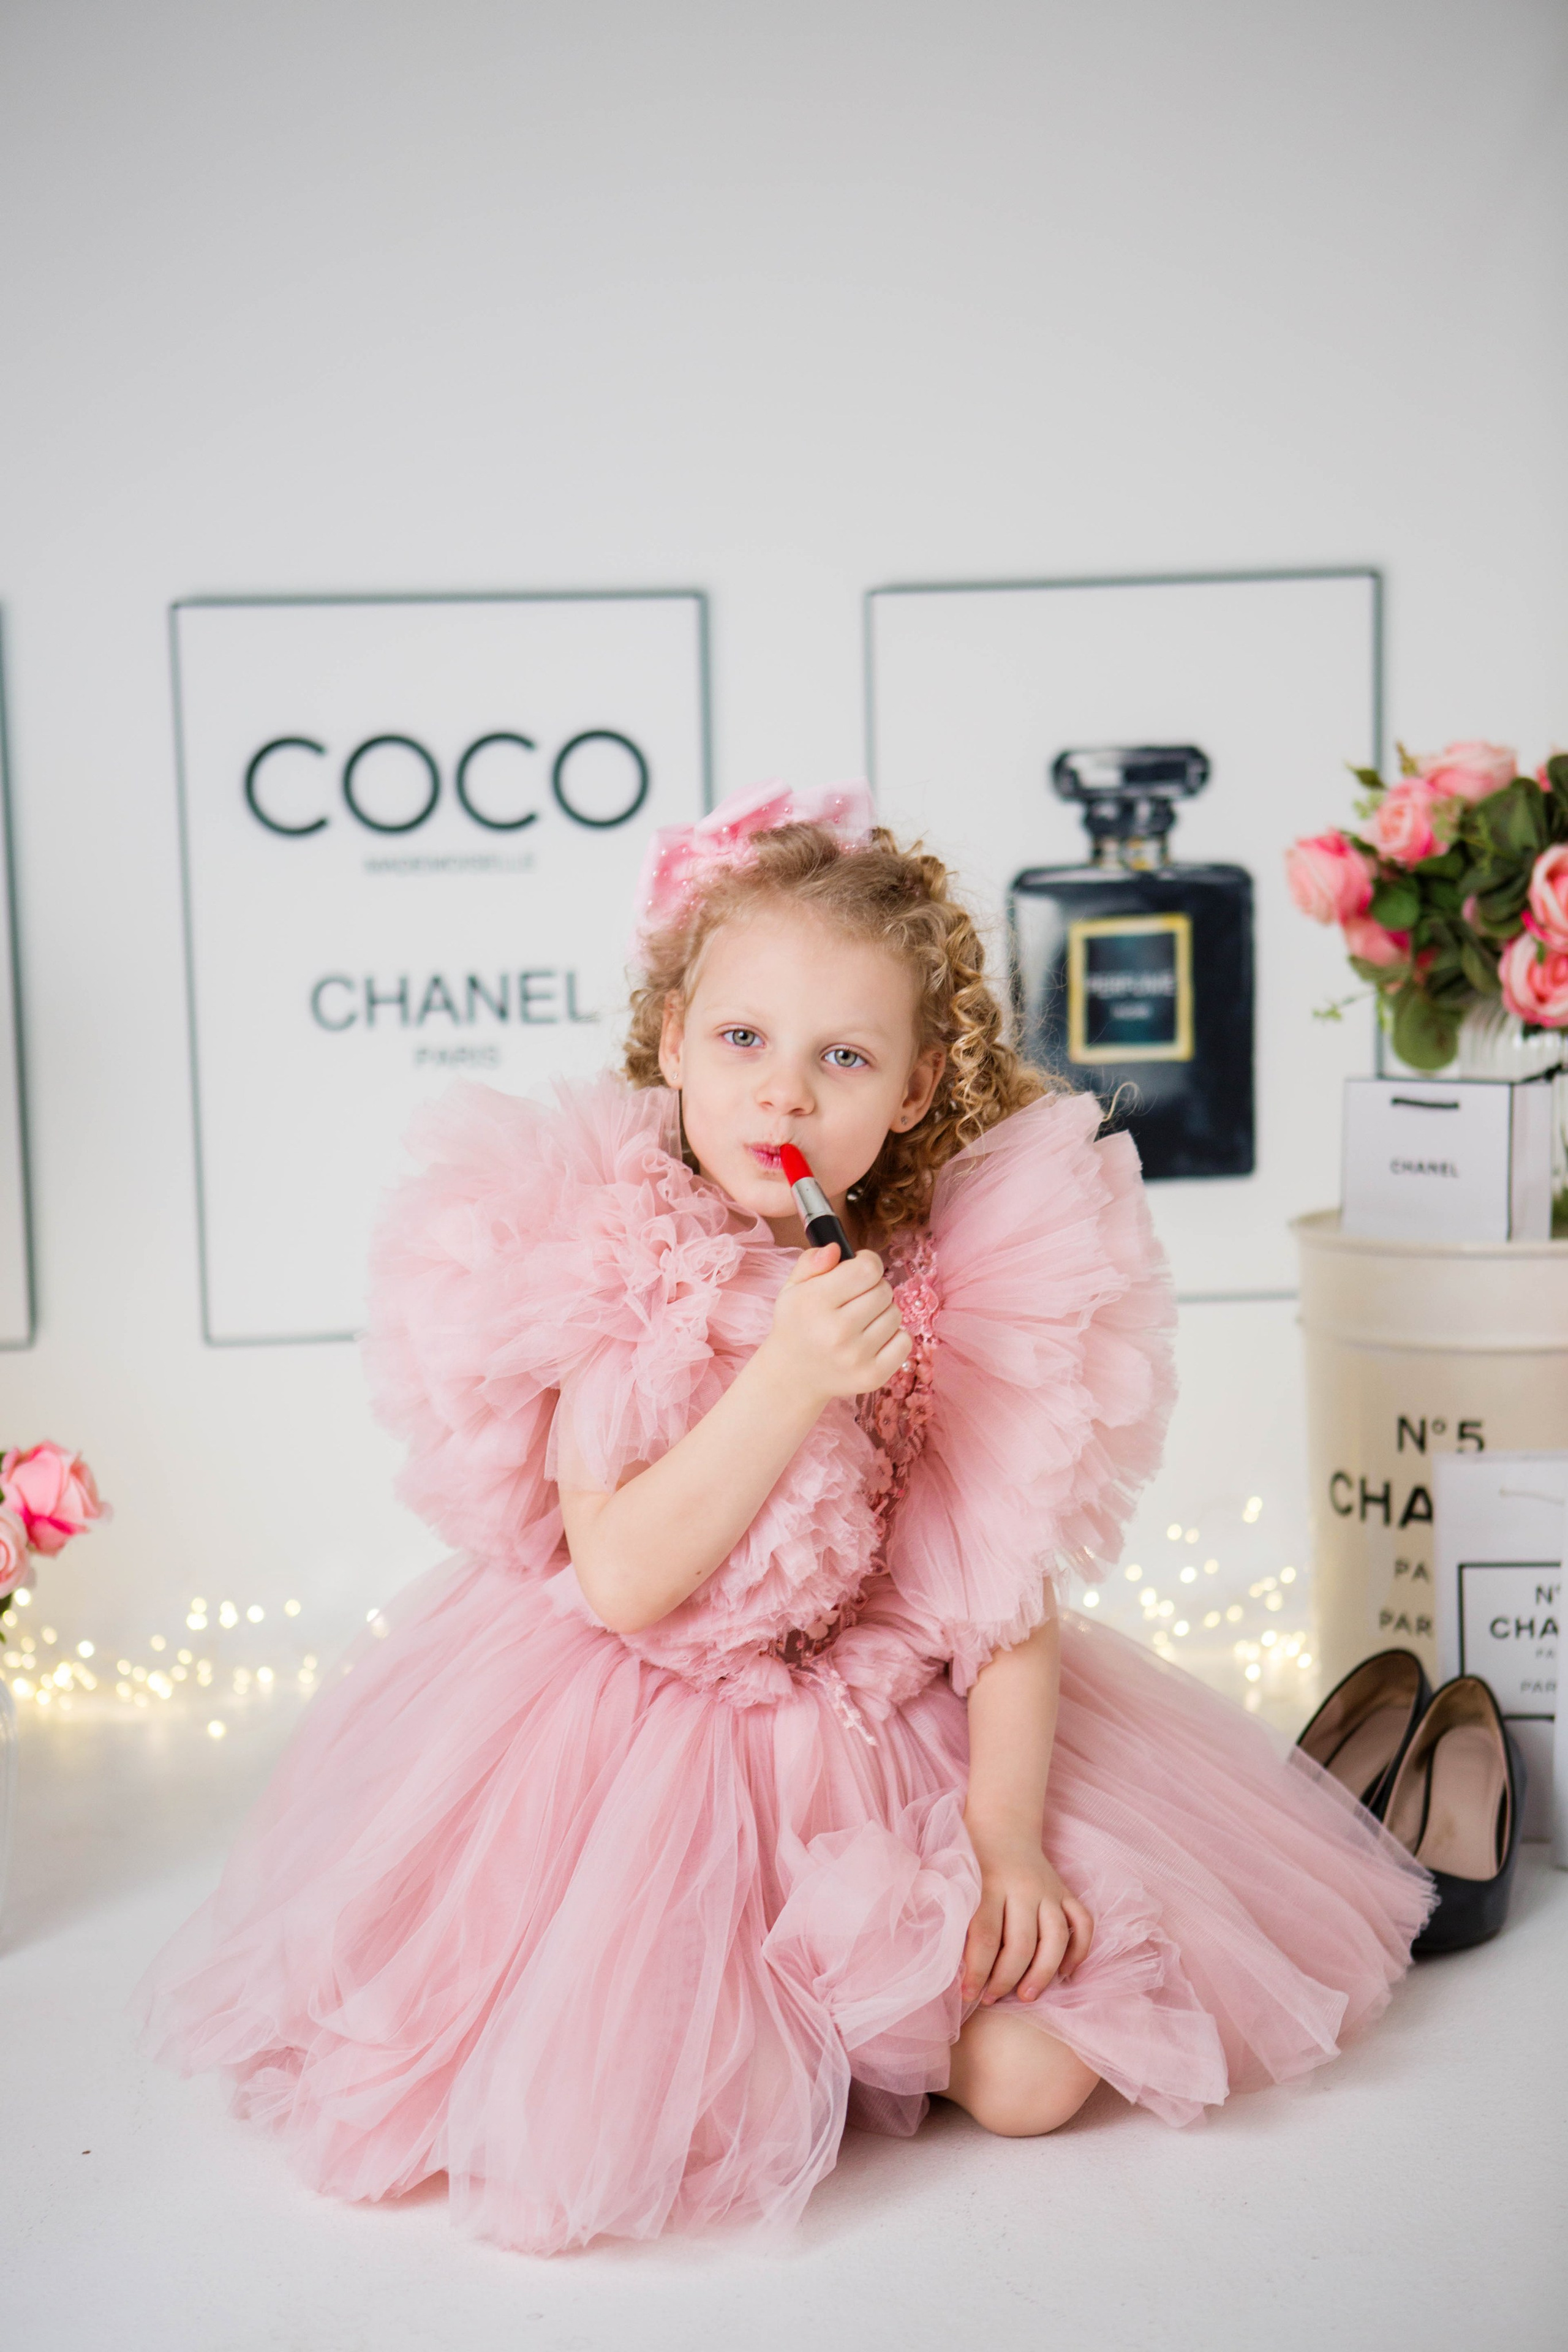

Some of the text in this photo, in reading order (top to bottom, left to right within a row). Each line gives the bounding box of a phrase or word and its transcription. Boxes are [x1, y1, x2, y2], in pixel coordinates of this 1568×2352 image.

[243, 728, 650, 835] COCO
[310, 968, 599, 1031] CHANEL
[415, 1046, 501, 1069] PARIS
[1389, 1158, 1460, 1178] CHANEL
[1329, 1471, 1434, 1528] CHA
[1395, 1558, 1430, 1583] PA
[1379, 1609, 1433, 1638] PAR
[1489, 1616, 1559, 1640] CHA
[1520, 1680, 1558, 1694] PAR
